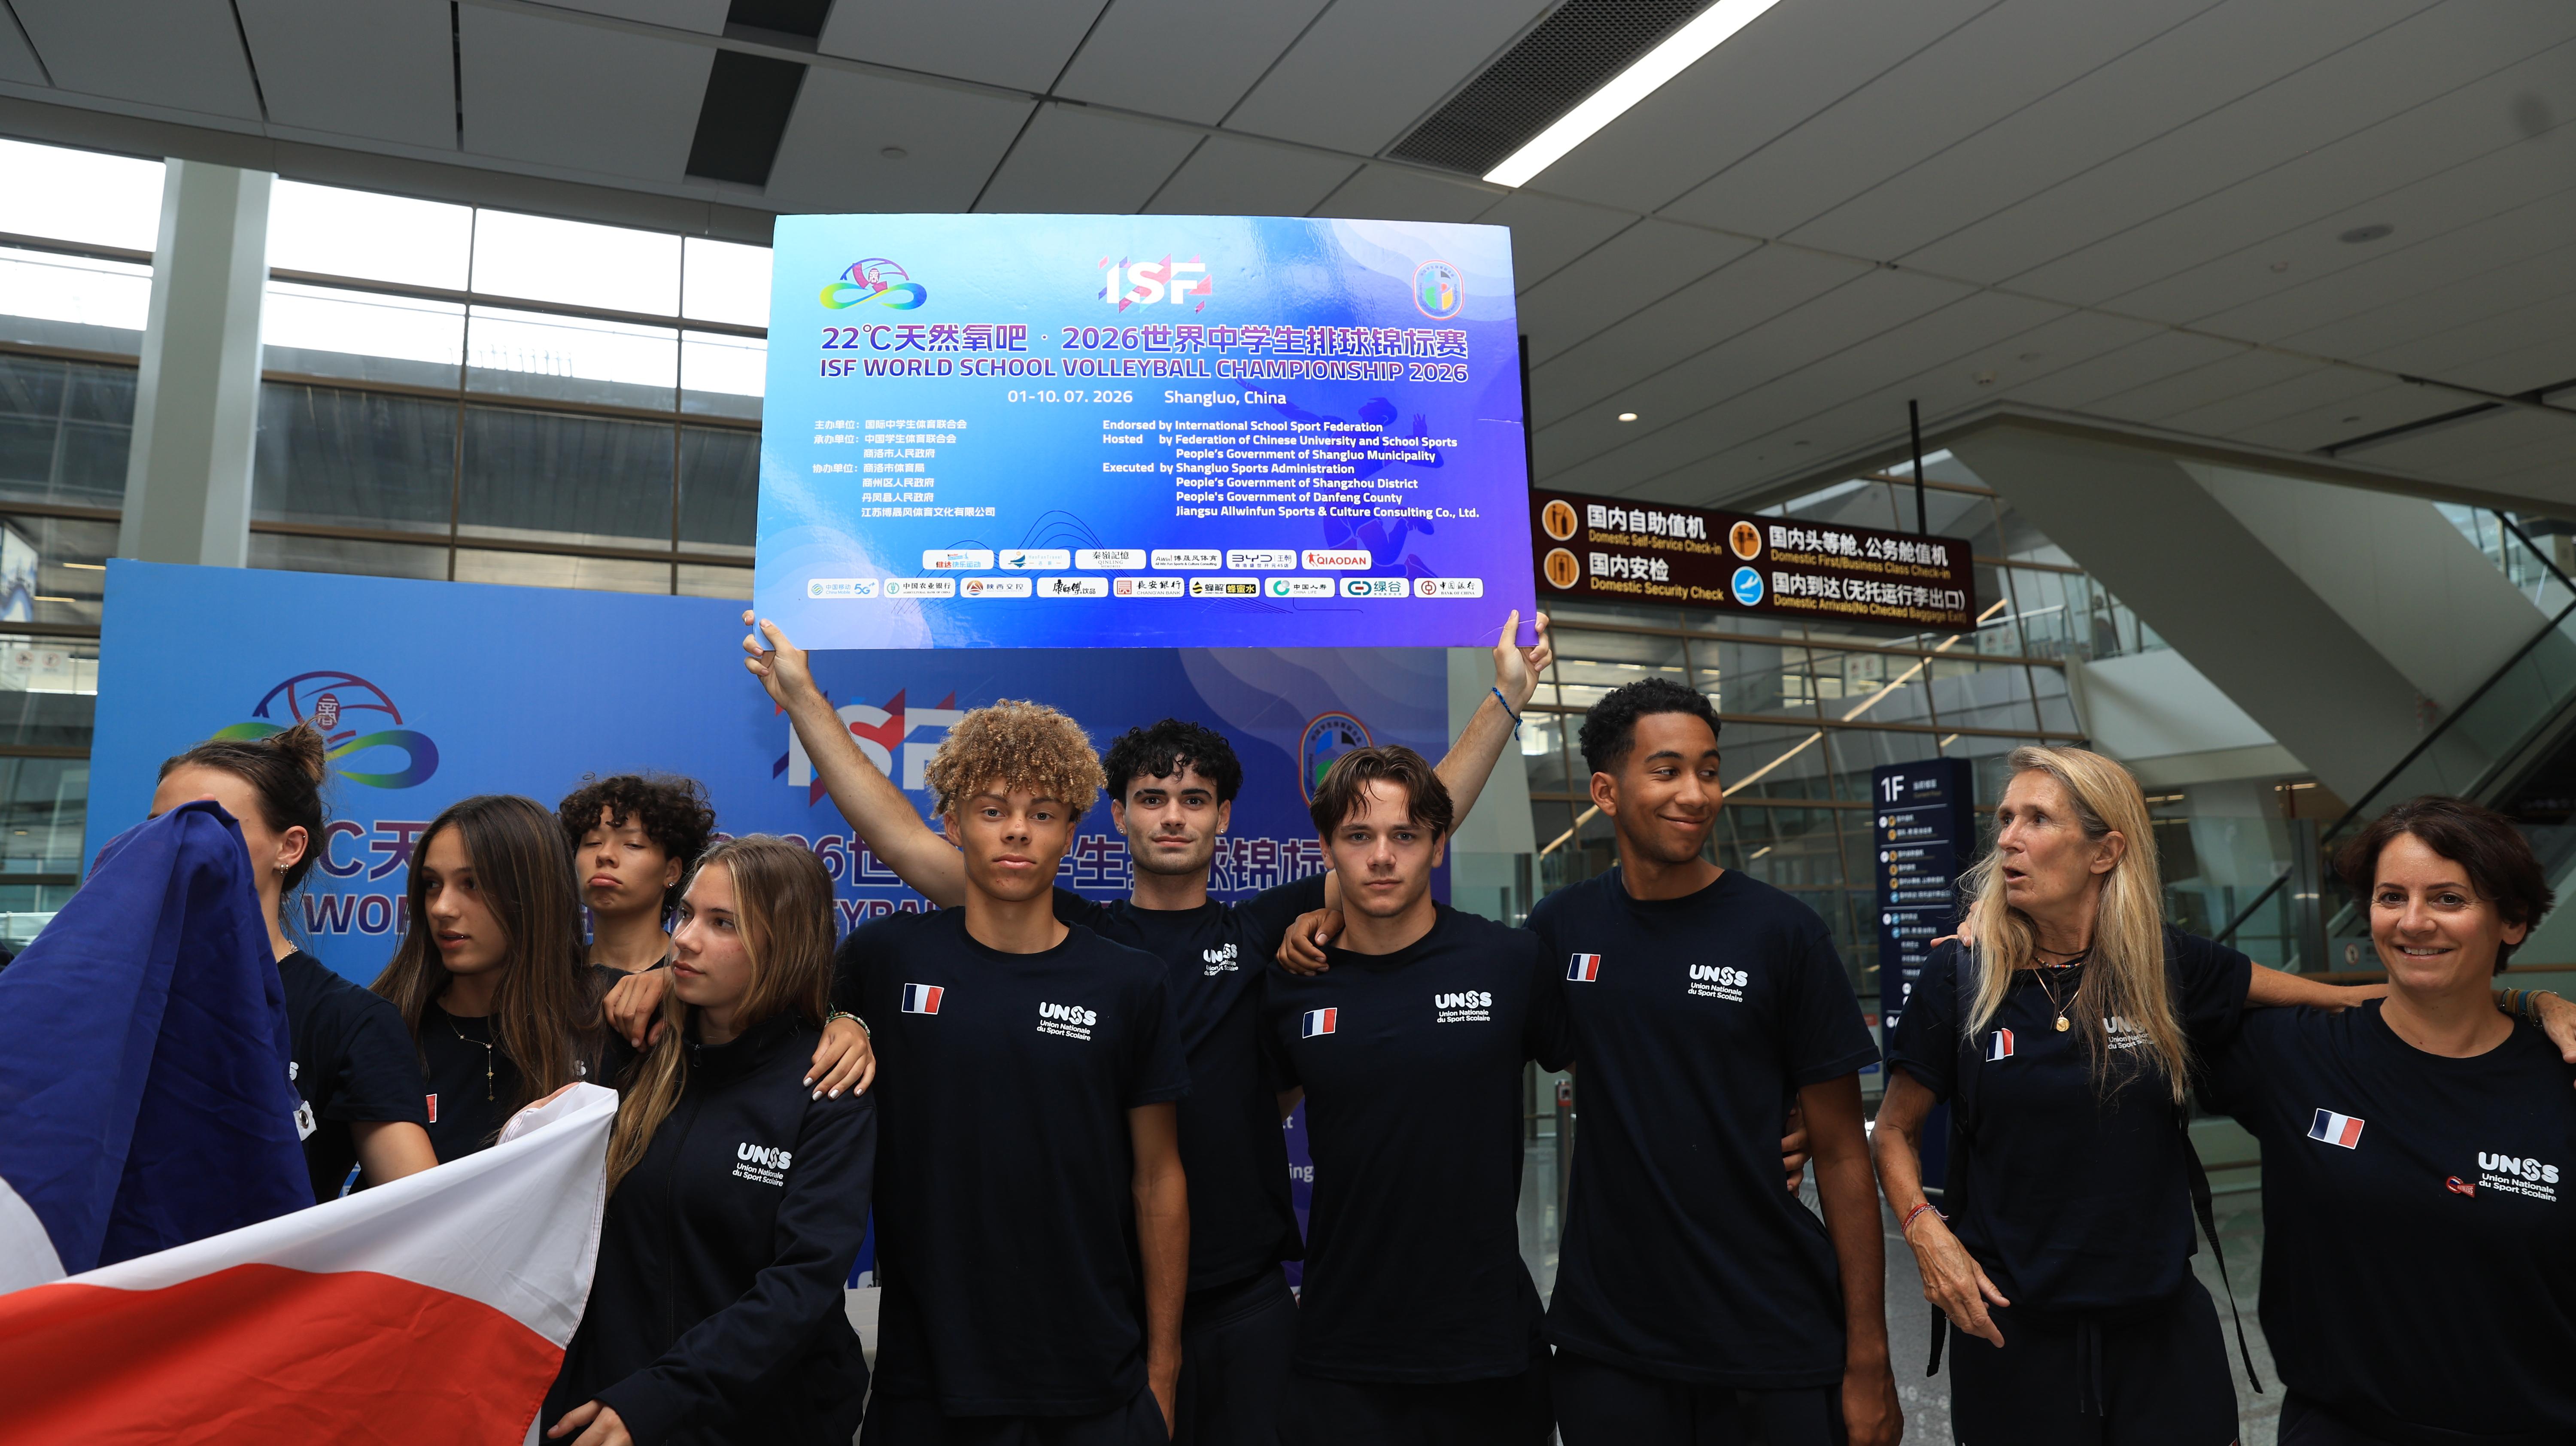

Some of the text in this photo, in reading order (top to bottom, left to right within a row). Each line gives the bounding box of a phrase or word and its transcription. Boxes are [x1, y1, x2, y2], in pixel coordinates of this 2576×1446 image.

[1106, 262, 1206, 306] ISF
[1061, 324, 1468, 359] 2026世界中学生排球锦标赛
[820, 358, 1469, 383] ISF WORLD SCHOOL VOLLEYBALL CHAMPIONSHIP 2026
[1092, 390, 1133, 403] 2026
[1164, 390, 1240, 406] Shangluo,
[1244, 390, 1287, 405] China
[865, 419, 967, 429] 国际中学生体育联合会
[1103, 420, 1383, 433] Endorsed by International School Sport Federation
[865, 434, 957, 444] 中国学生体育联合会
[1103, 434, 1458, 449] Hosted by Federation of Chinese University and School Sports
[863, 449, 936, 459] 商洛市人民政府
[1227, 449, 1295, 459] Government
[1298, 450, 1310, 459] of
[1312, 450, 1364, 462] Shangluo
[1367, 450, 1436, 463] Municipality
[863, 463, 925, 473] 商洛市体育局
[1103, 462, 1355, 475] Executed by Shangluo Sports Administration
[862, 478, 934, 488] 商州区人民政府
[1227, 477, 1296, 488] Government
[1298, 478, 1310, 488] of
[1312, 478, 1375, 491] Shangzhou
[1377, 479, 1419, 489] District
[862, 492, 934, 502] 丹凤县人民政府
[1176, 492, 1403, 505] People's Government of Danfeng County
[861, 507, 995, 517] 江苏博晟风体育文化有限公司
[1176, 506, 1479, 519] Jiangsu Allwinfun Sports & Culture Consulting Co., Ltd.
[1587, 504, 1707, 540] 国内自助值机
[1589, 529, 1722, 555] Domestic Self-Service Check-in
[1768, 525, 1949, 567] 国内头等舱、公务舱值机
[1589, 552, 1670, 582] 国内安检
[1771, 548, 1951, 580] Domestic First/Business Class Check-in
[1227, 585, 1255, 593] 蜂蜜水
[1374, 581, 1401, 592] 绿谷
[1590, 577, 1724, 601] Domestic Security Check
[1773, 593, 1817, 611] Domestic
[1868, 603, 1908, 618] Checked
[1908, 605, 1947, 623] Baggage
[1947, 610, 1967, 623] Exit)
[1880, 775, 1905, 802] 1F
[1689, 964, 1748, 987] UNSS
[1691, 982, 1742, 996] Union Nationale
[1697, 989, 1716, 997] Sport
[1716, 992, 1743, 1002] Scolaire
[1435, 990, 1492, 1009] UNSS
[1039, 1001, 1097, 1026] UNSS
[1040, 1019, 1091, 1035] Union Nationale
[1046, 1027, 1065, 1036] Sport
[1065, 1030, 1091, 1041] Scolaire
[2117, 1041, 2137, 1049] Sport
[737, 1142, 792, 1170] UNSS
[736, 1162, 784, 1179] Union Nationale
[2478, 1151, 2559, 1184] UNSS
[743, 1171, 762, 1182] Sport
[762, 1176, 784, 1187] Scolaire
[2482, 1173, 2555, 1194] Union Nationale
[2493, 1183, 2520, 1194] Sport
[2521, 1188, 2557, 1203] Scolaire
